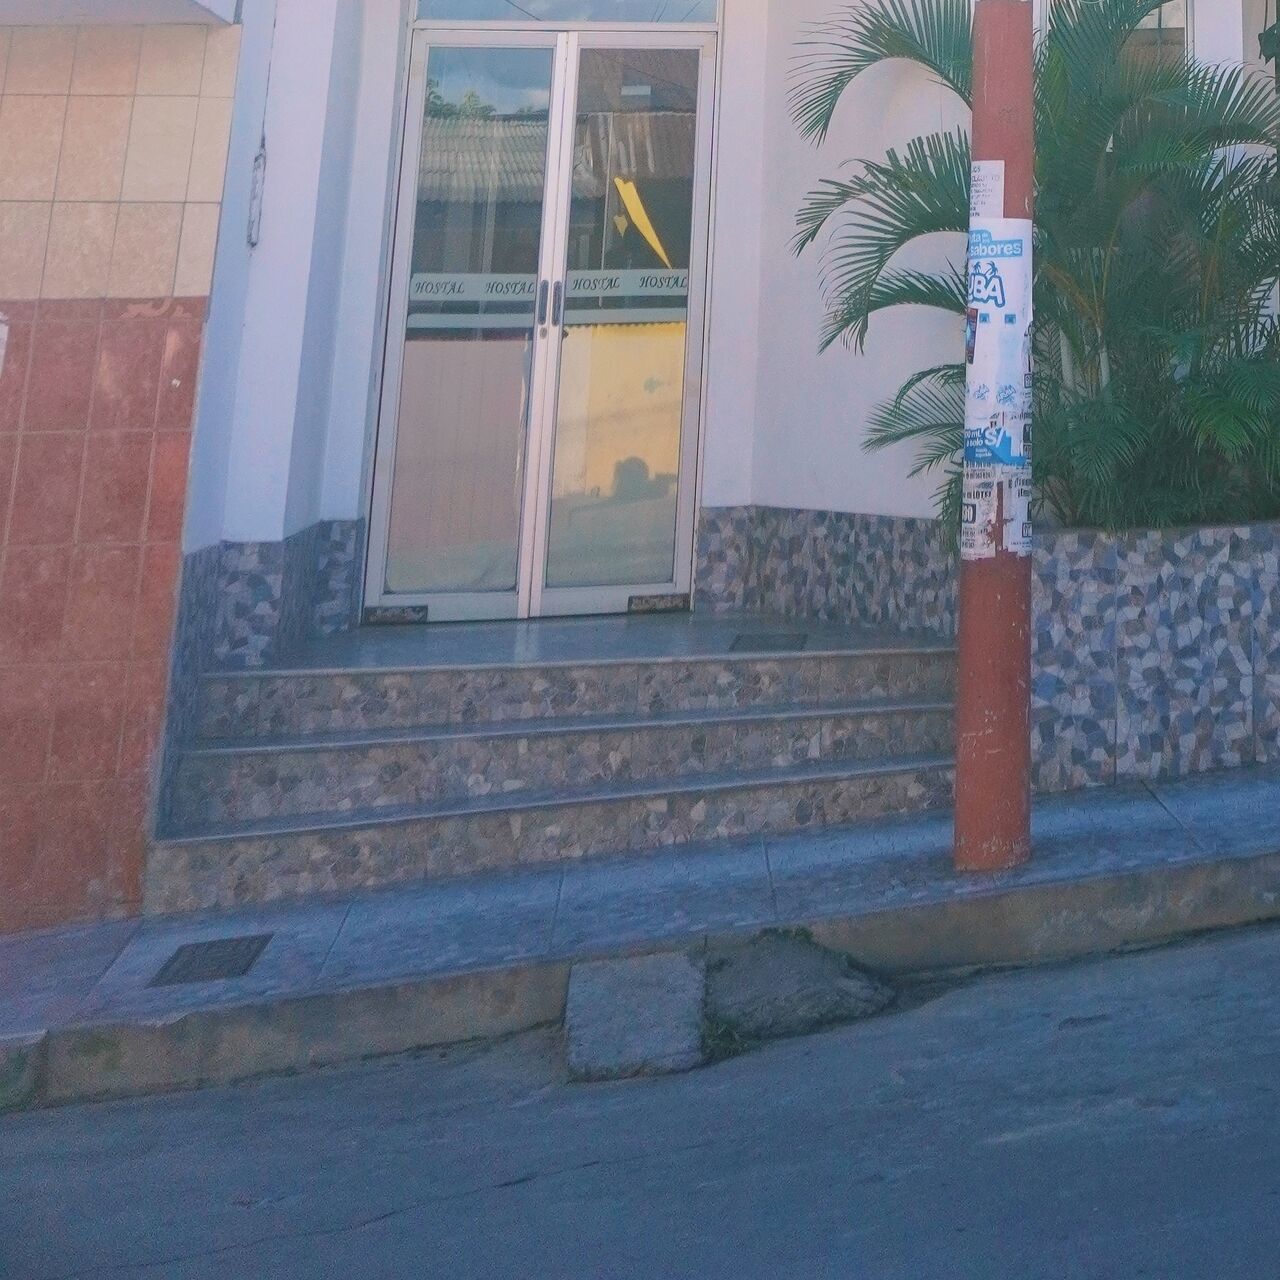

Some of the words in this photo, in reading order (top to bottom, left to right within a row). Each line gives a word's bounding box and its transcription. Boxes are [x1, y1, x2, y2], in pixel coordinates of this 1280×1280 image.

[415, 280, 465, 295] HOSTAL
[486, 280, 535, 295] HOSTAL
[572, 277, 620, 291] HOSTAL
[639, 275, 687, 289] HOSTAL
